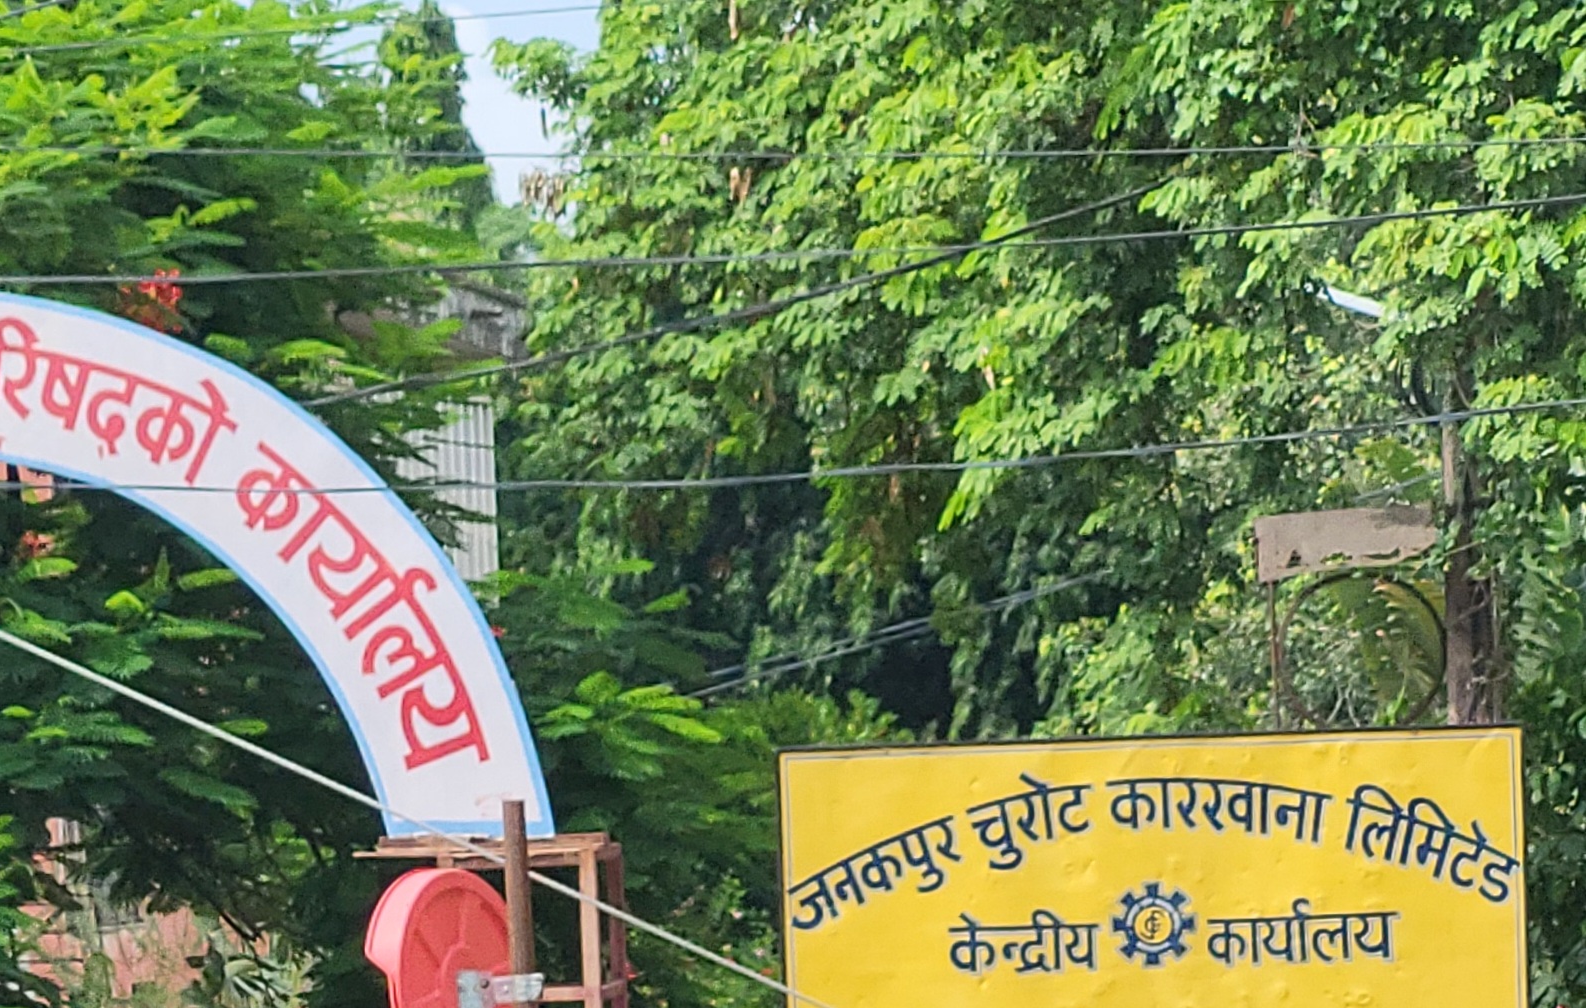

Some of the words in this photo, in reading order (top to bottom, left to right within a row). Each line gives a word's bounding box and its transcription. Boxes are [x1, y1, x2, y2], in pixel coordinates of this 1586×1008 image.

[235, 441, 490, 772] कार्यालय
[787, 815, 963, 930] जनकपुर
[966, 772, 1092, 870] चुरोट
[1345, 783, 1521, 903] लिमिटेड
[948, 909, 1100, 974] केन्द्रीय
[1206, 898, 1399, 965] कार्यालय
